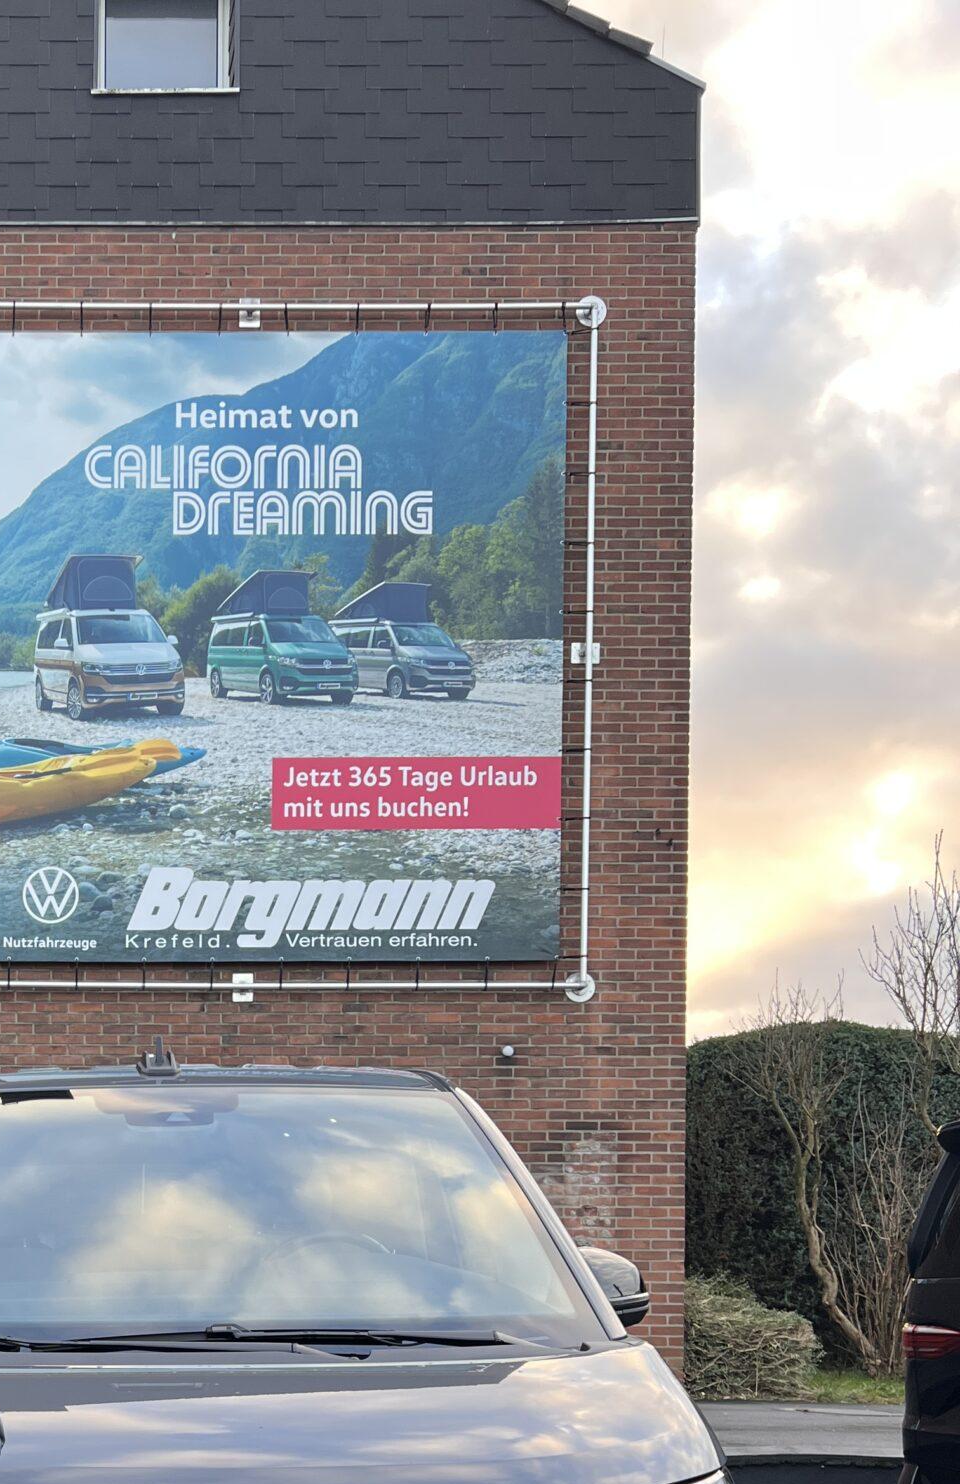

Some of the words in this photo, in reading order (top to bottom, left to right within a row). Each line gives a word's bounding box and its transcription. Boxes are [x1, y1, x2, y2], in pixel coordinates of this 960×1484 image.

[175, 402, 292, 429] Heimat
[300, 408, 359, 429] von
[84, 444, 363, 489] CALIFORNIA
[172, 490, 434, 535] DREAMING
[283, 766, 342, 787] Jetzt
[348, 766, 391, 787] 365
[398, 766, 453, 792] Tage
[460, 765, 538, 787] Urlaub
[283, 797, 323, 817] mit
[330, 801, 371, 817] uns
[377, 796, 469, 817] buchen!
[126, 867, 496, 948] Borgmann
[3, 936, 97, 951] Nutzfahrzeuge
[125, 934, 231, 948] Krefeld.
[286, 933, 382, 947] Vertrauen
[389, 932, 478, 947] erfahren.
